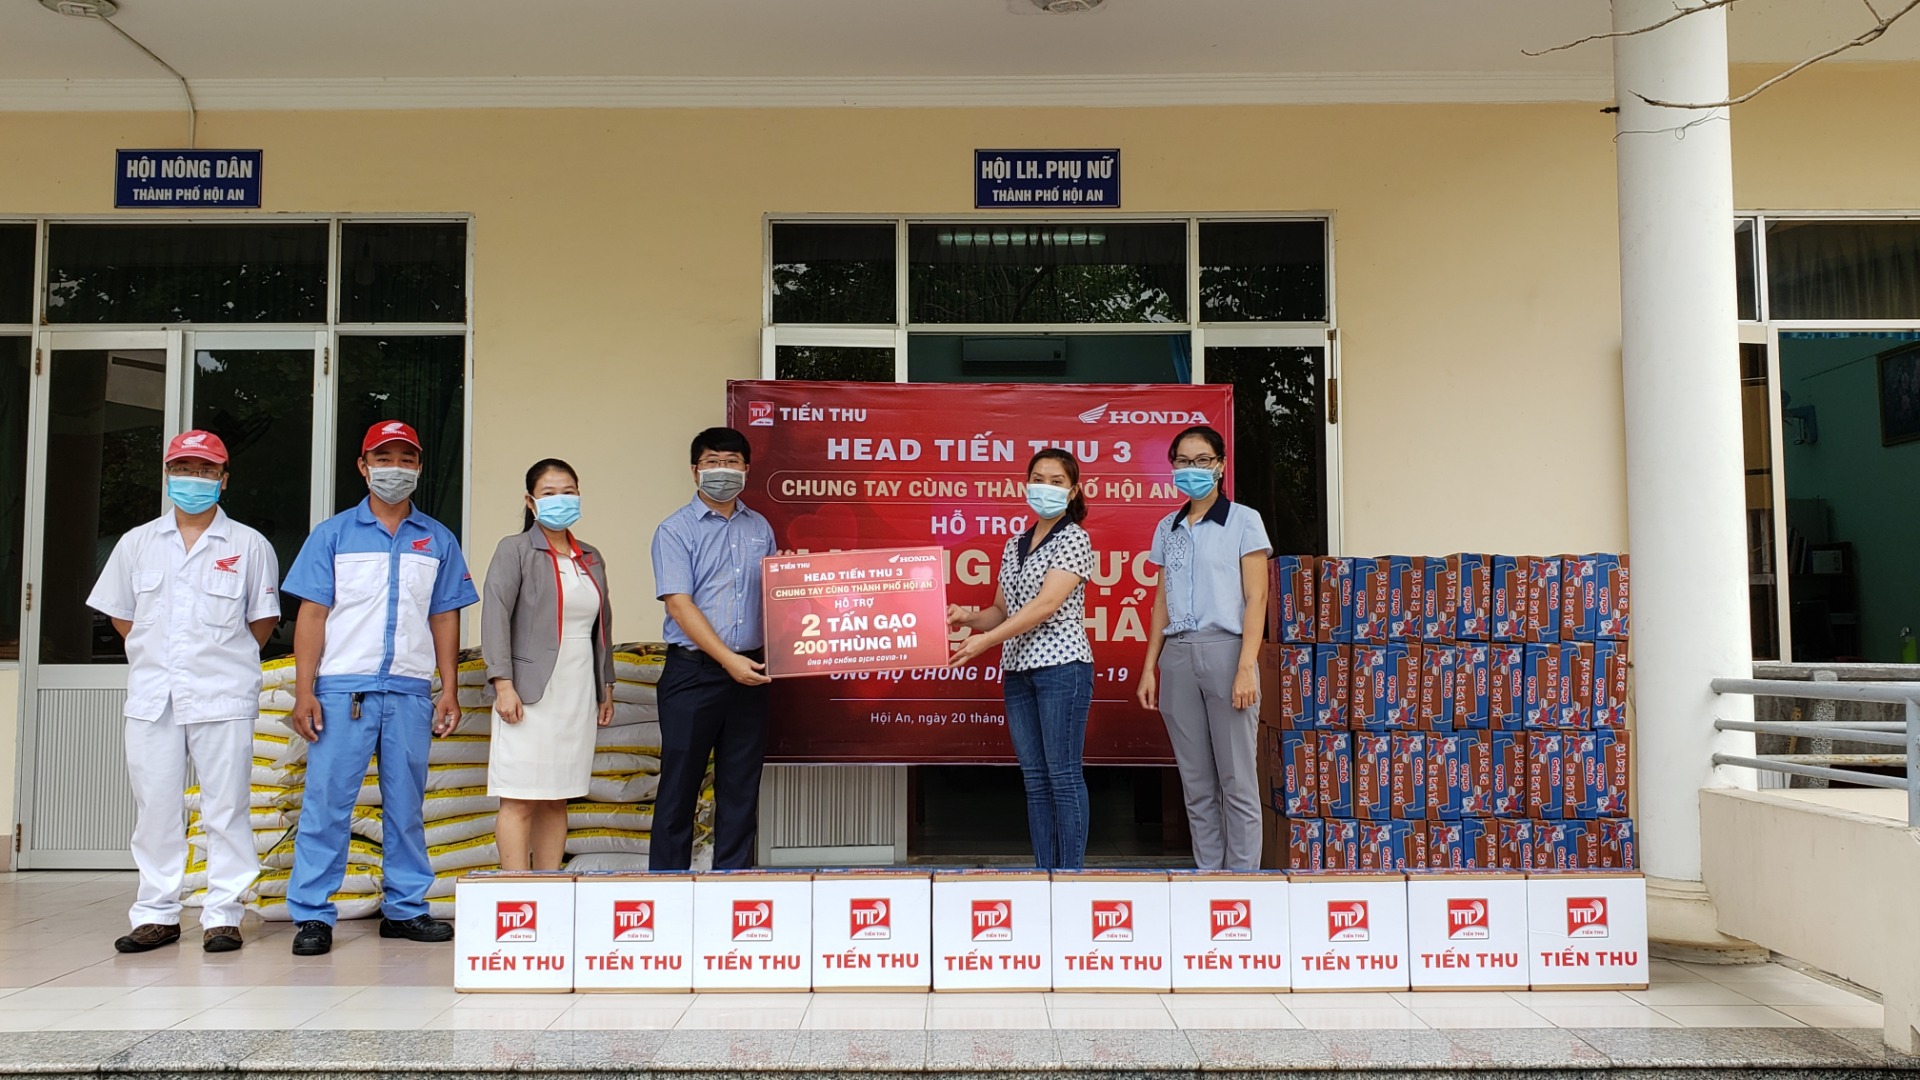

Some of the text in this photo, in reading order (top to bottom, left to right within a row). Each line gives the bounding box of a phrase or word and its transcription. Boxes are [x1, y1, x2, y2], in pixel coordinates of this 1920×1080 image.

[126, 156, 253, 182] HỘI NÔNG DÂN
[982, 156, 1114, 183] HỘI LH. PHỤ NỮ
[133, 184, 244, 203] THÀNH PHỐ HỘI AN
[992, 185, 1103, 204] THÀNH PHỐ HỘI AN
[780, 402, 867, 422] TIẾN THU
[1108, 410, 1210, 424] HONDA
[828, 438, 922, 460] HEAD
[934, 431, 1014, 462] TIẾN
[1112, 441, 1131, 462] 3
[782, 479, 857, 496] CHUNG
[864, 480, 902, 496] TAY
[909, 474, 968, 499] CÙNG
[975, 474, 1028, 499] THÀN
[1106, 478, 1142, 502] HỘI
[1149, 482, 1178, 499] AN
[931, 509, 966, 535] HỖ
[780, 561, 796, 570] TIẾN
[804, 572, 835, 582] HEAD
[838, 568, 865, 579] TIẾN
[868, 570, 893, 578] THU
[776, 581, 932, 598] CHUNG TAY CÙNG THÀNH PHỐ HỘI AN
[852, 597, 874, 609] TRỢ
[801, 614, 820, 637] 2
[827, 611, 868, 632] TẤN
[873, 613, 916, 633] GẠO
[794, 631, 917, 655] 200 THÙNG MÌ
[823, 657, 833, 666] HỘ
[834, 656, 858, 665] CHỐNG
[858, 655, 875, 664] DỊCH
[876, 654, 907, 662] COVID-19
[871, 711, 1004, 726] Hội An, ngày 20 tháng
[468, 949, 564, 970] TIẾN THU
[585, 949, 682, 970] TIẾN THU
[704, 948, 800, 970] TIẾN THU
[823, 947, 919, 969] TIẾN THU
[945, 948, 1041, 970] TIẾN THU
[1065, 948, 1162, 970] TIẾN THU
[1184, 948, 1281, 969] TIẾN THU
[1301, 949, 1398, 970] TIẾN THU
[1421, 947, 1518, 968] TIẾN THU
[1541, 945, 1638, 966] TIẾN THU
